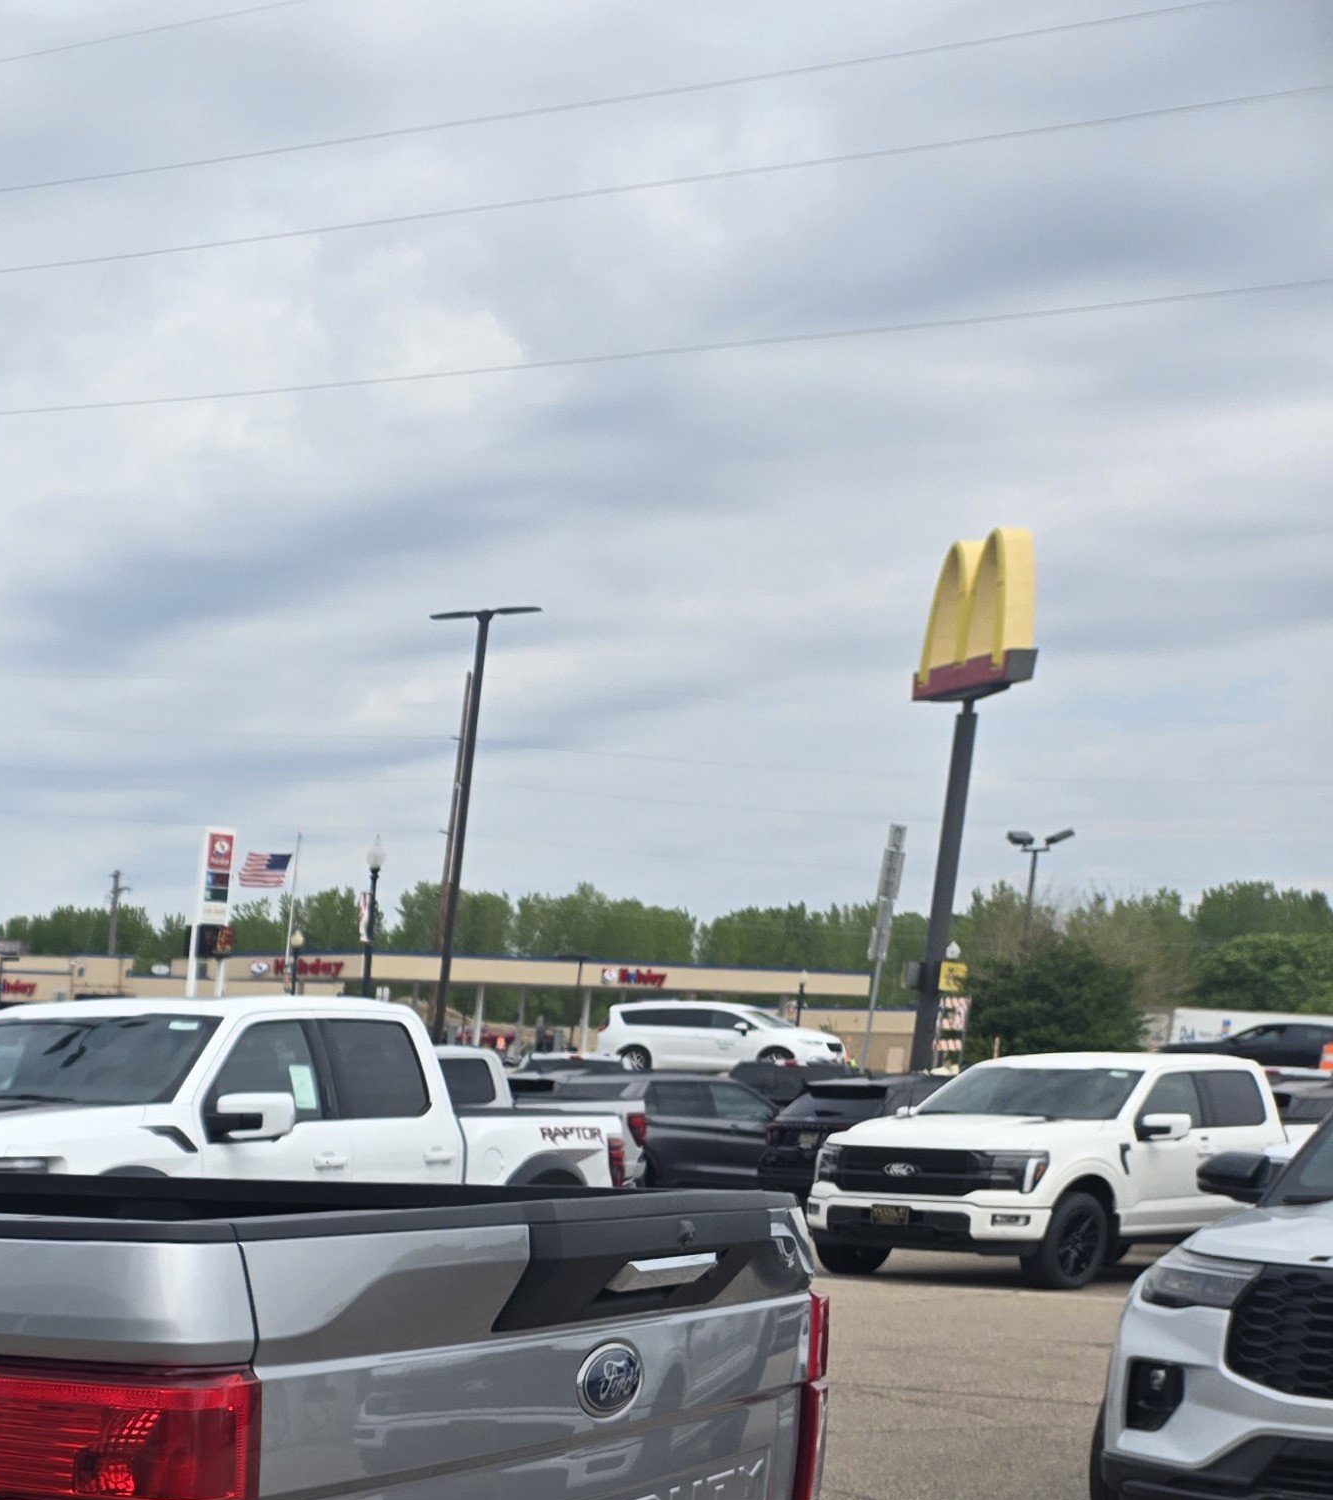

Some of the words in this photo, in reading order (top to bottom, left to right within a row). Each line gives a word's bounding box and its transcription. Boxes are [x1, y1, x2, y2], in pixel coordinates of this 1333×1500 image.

[274, 957, 343, 978] Hliday
[539, 1126, 605, 1147] RAPTOR
[599, 1360, 641, 1400] Ford
